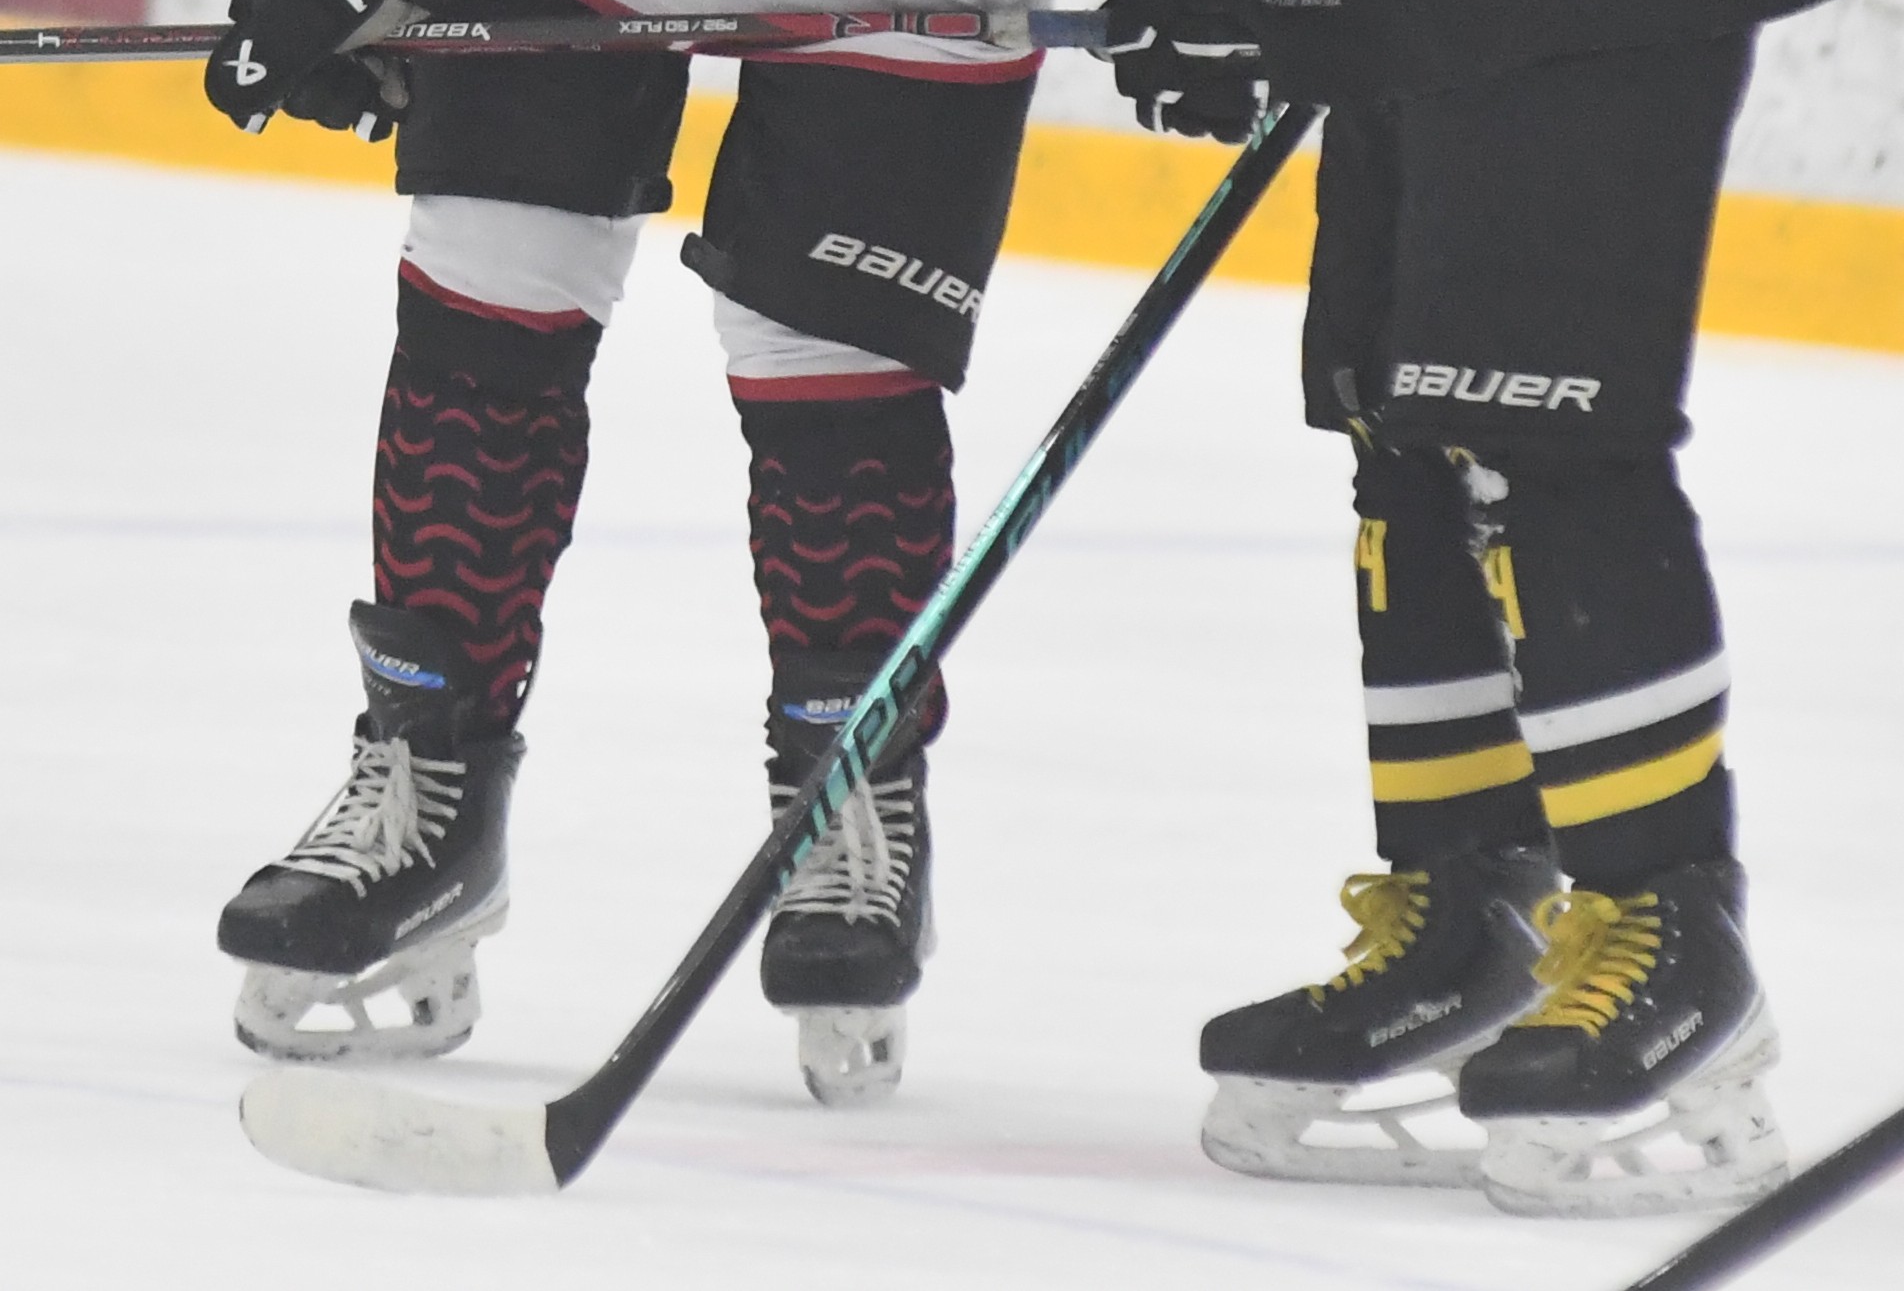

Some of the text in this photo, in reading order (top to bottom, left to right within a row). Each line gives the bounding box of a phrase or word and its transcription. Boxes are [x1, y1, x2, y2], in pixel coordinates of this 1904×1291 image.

[386, 22, 470, 39] BAUE
[807, 232, 984, 324] BAUER
[1393, 363, 1602, 413] BAUER
[1642, 1011, 1704, 1071] BAUER
